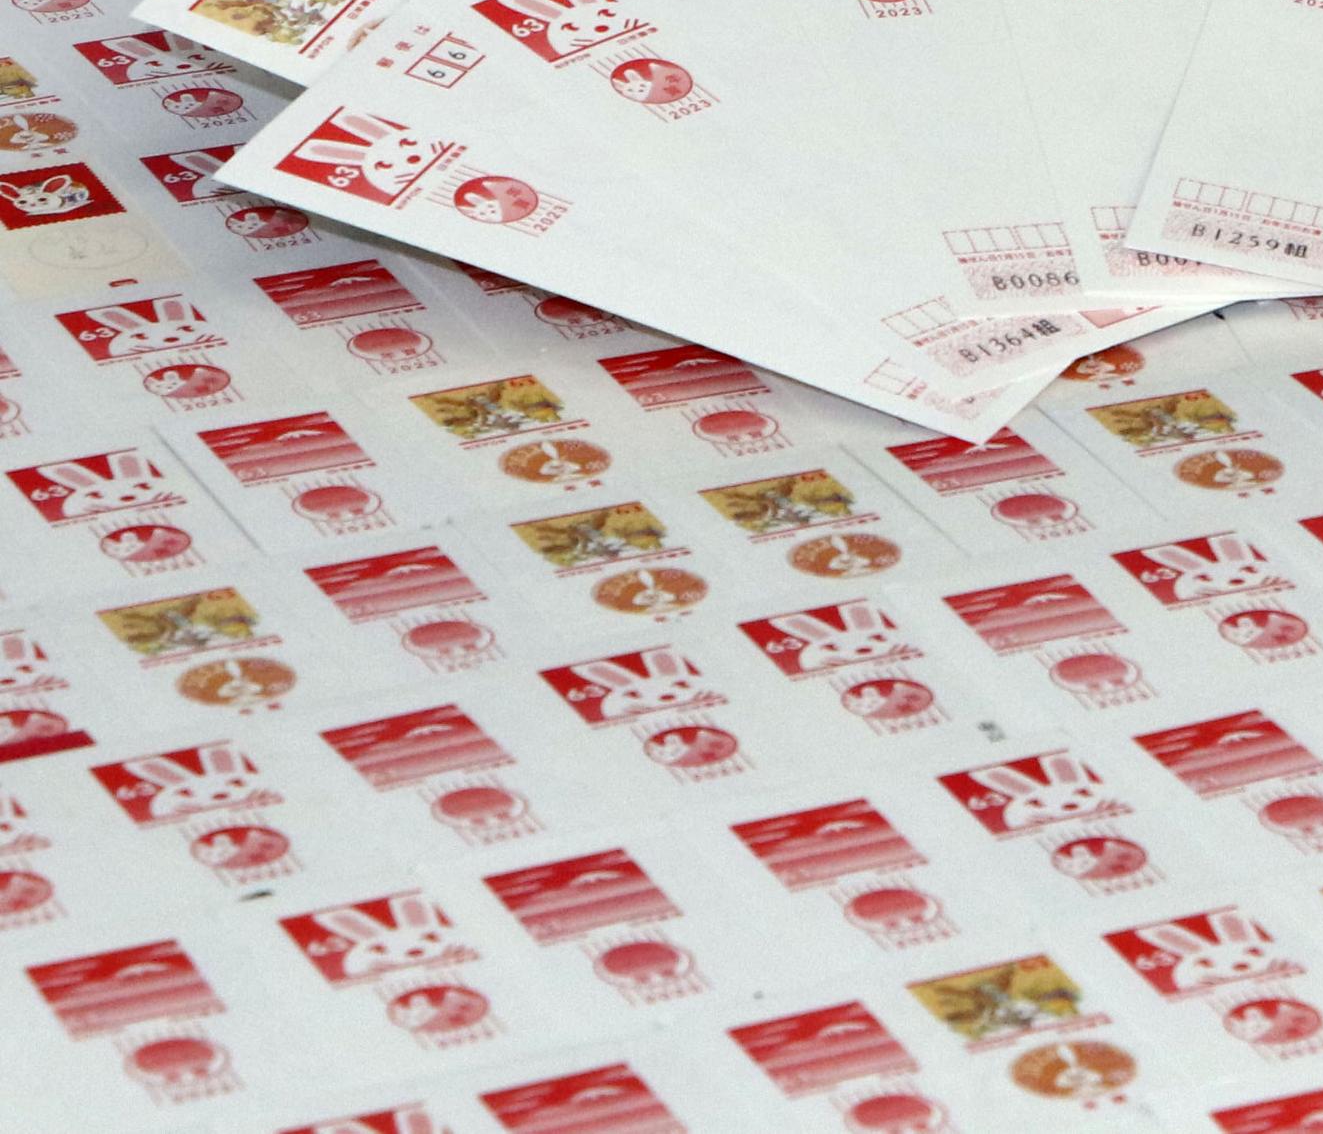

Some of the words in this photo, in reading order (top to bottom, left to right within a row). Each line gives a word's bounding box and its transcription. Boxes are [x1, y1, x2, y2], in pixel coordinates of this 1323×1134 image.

[47, 11, 95, 25] 2023
[876, 7, 923, 18] 2023
[512, 18, 546, 38] 63
[98, 56, 131, 69] 63
[669, 99, 712, 122] 2023
[199, 115, 250, 130] 2023
[164, 171, 197, 184] 63
[327, 165, 360, 187] 63
[536, 205, 568, 231] 2023
[1191, 223, 1309, 259] B1259組
[992, 271, 1080, 291] B0086
[79, 327, 116, 343] 63
[959, 319, 1060, 363] B1364組
